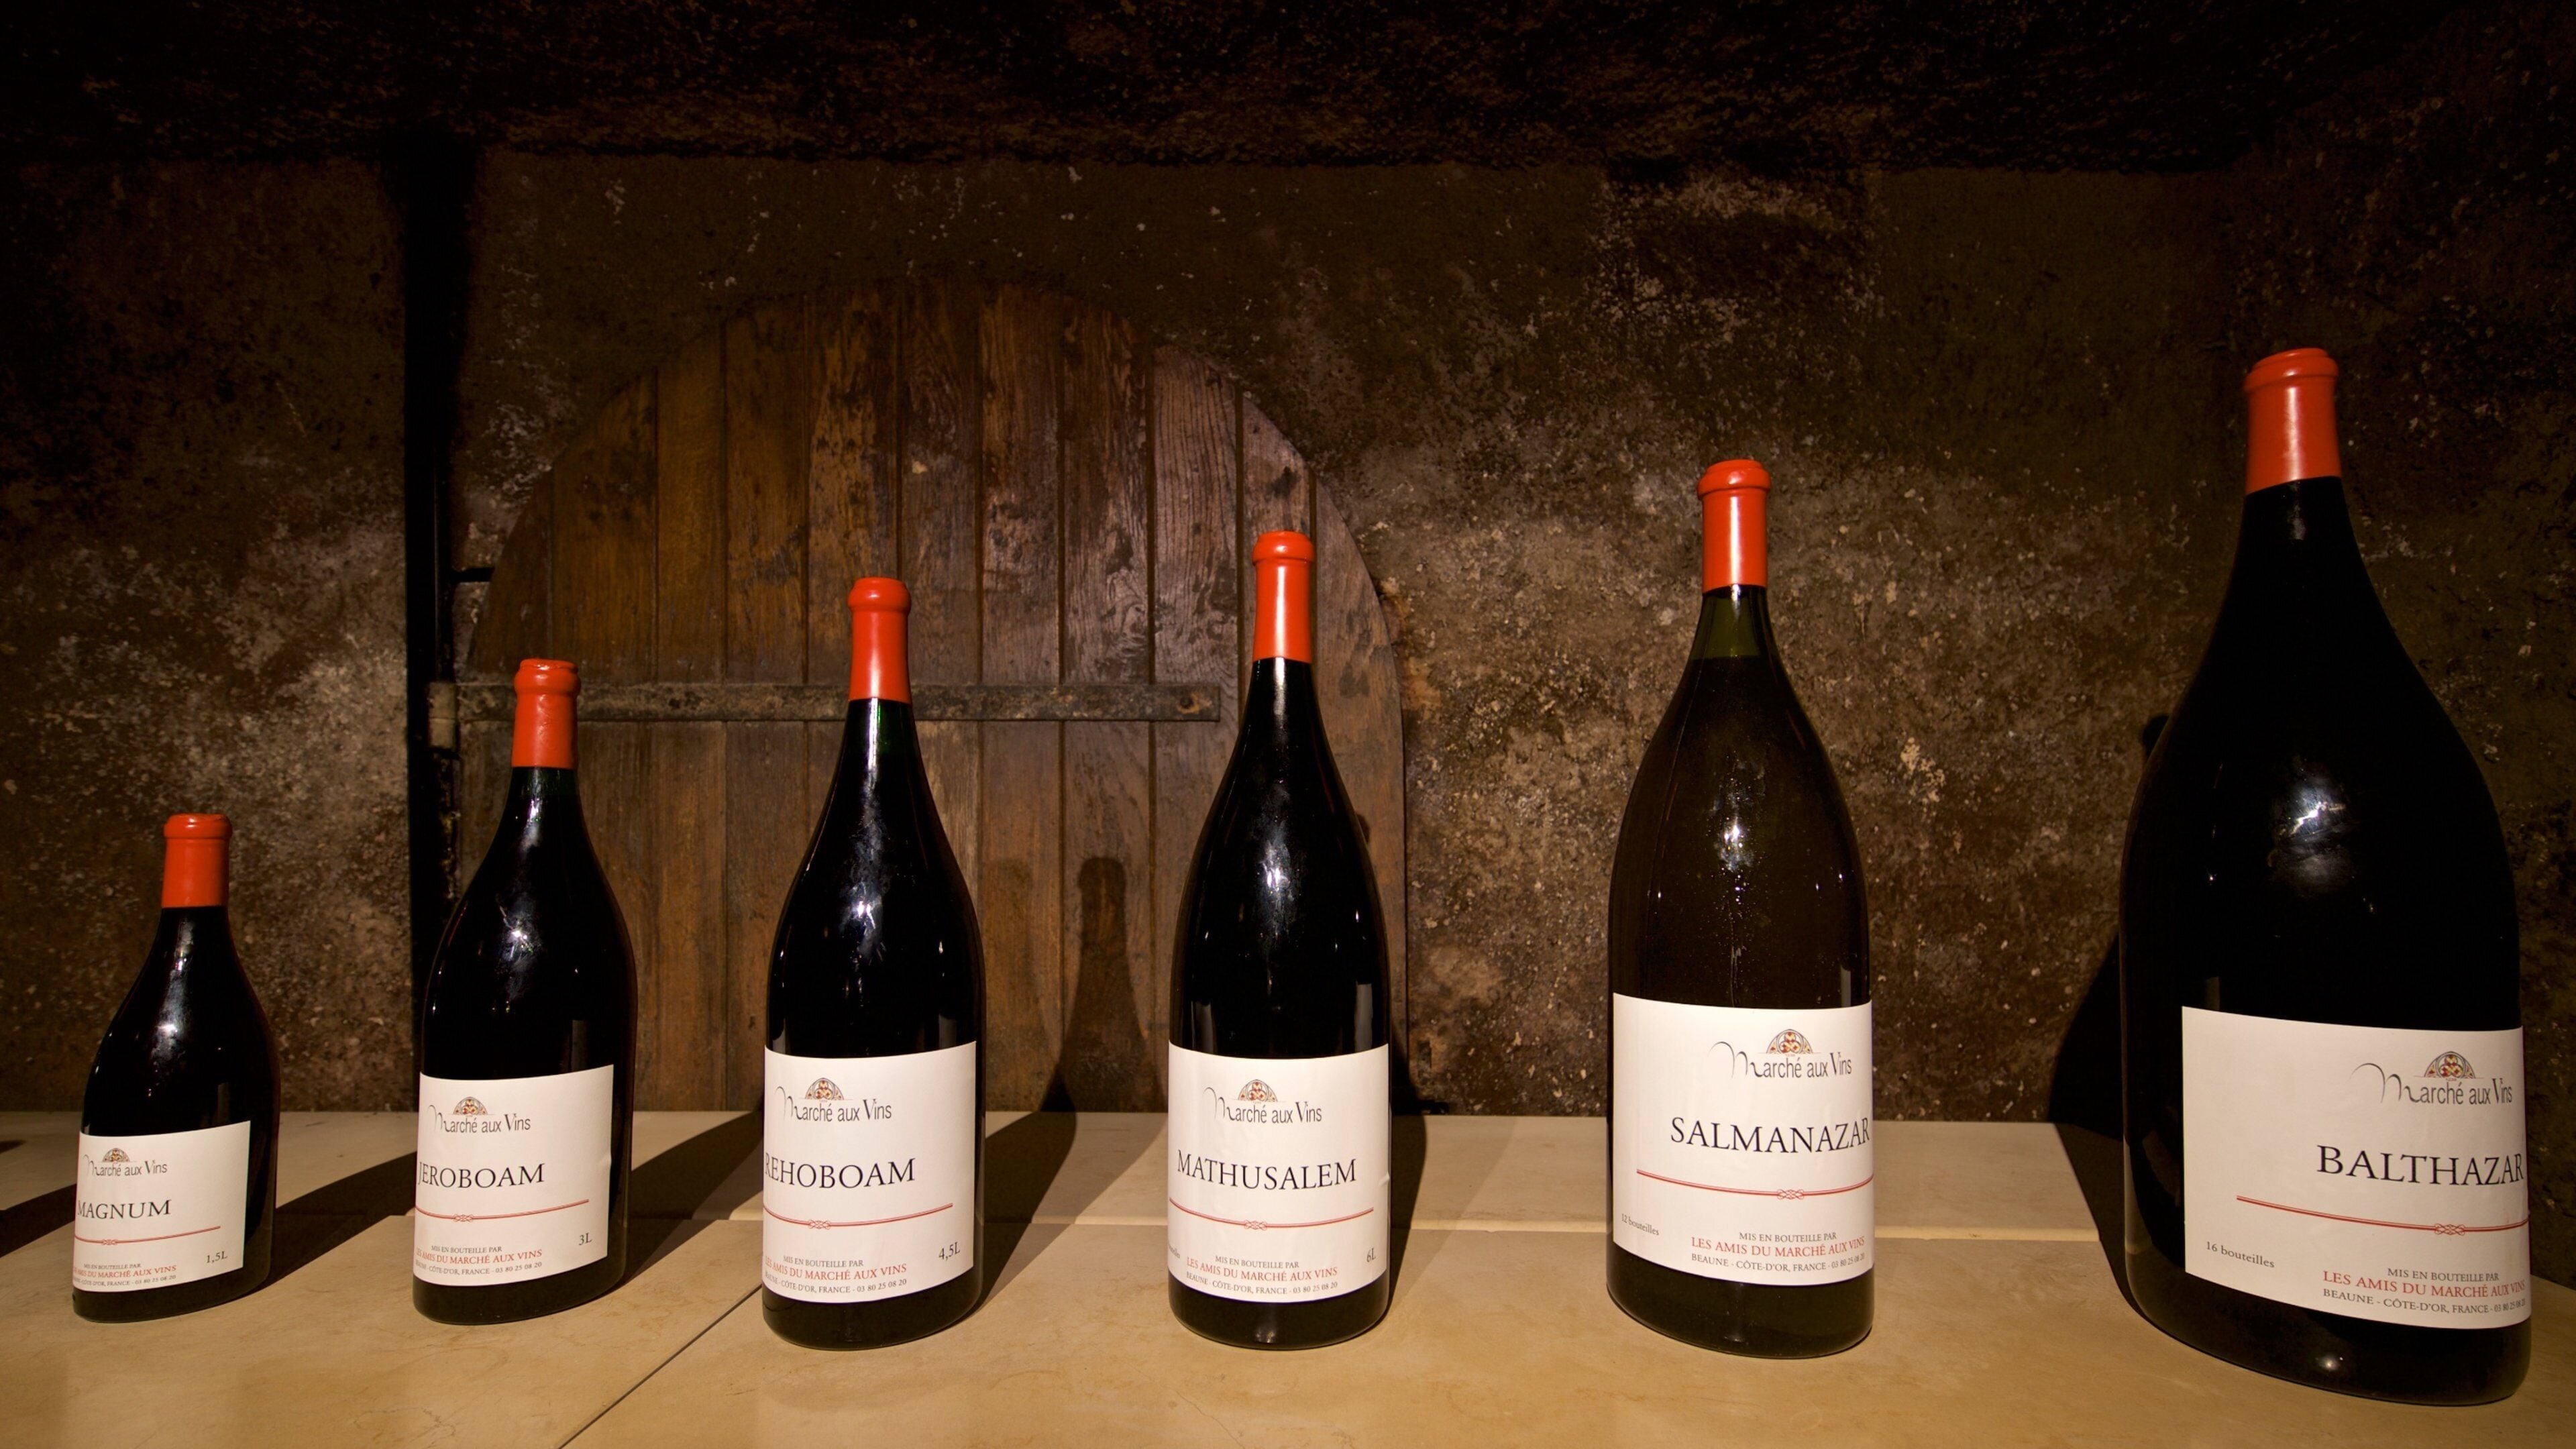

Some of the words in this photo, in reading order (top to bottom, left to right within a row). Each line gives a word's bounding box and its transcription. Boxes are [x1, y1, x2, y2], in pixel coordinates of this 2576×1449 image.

[1707, 1041, 1801, 1078] Marché
[1807, 1062, 1828, 1077] aux
[1829, 1052, 1851, 1075] Vins
[2350, 1063, 2464, 1105] Marché
[2469, 1088, 2490, 1104] aux
[2491, 1077, 2512, 1104] Vins
[775, 1086, 833, 1122] Marché
[837, 1106, 860, 1122] aux
[863, 1099, 892, 1120] Vins
[1203, 1087, 1267, 1124] Marché
[1271, 1108, 1293, 1124] aux
[1295, 1102, 1322, 1123] Vins
[427, 1105, 477, 1133] Marché
[481, 1120, 502, 1133] aux
[504, 1113, 531, 1132] Vins
[1670, 1116, 1870, 1153] SALMANAZAR
[84, 1154, 121, 1177] Marché
[124, 1163, 142, 1176] aux
[144, 1161, 168, 1175] Vins
[418, 1162, 545, 1189] JEROBOAM
[765, 1152, 916, 1189] REHOBOAM
[1177, 1149, 1356, 1191] MATHUSALEM
[2316, 1144, 2524, 1186] BALTHAZAR
[77, 1199, 172, 1220] MAGNUM
[1628, 1216, 1659, 1236] bouteilles
[578, 1232, 592, 1246] 3L
[1691, 1237, 1711, 1249] LES
[1715, 1242, 1747, 1254] AMIS
[1752, 1245, 1771, 1256] DU
[1775, 1244, 1825, 1257] MARCHÉ
[1828, 1242, 1847, 1254] AUX
[1849, 1236, 1865, 1249] VINS
[1739, 1232, 1757, 1240] MIS
[1774, 1234, 1822, 1242] BOUTEILLE
[1824, 1232, 1837, 1240] PAR
[206, 1250, 228, 1264] 1,5L
[449, 1256, 490, 1265] MARCHÉ
[493, 1254, 515, 1263] AUX
[517, 1249, 542, 1260] VINS
[938, 1241, 960, 1261] 4,5L
[1366, 1247, 1376, 1263] 6L
[2206, 1241, 2218, 1252] 16
[2221, 1245, 2275, 1269] bouteilles
[772, 1264, 788, 1275] AMIS
[790, 1267, 802, 1278] DU
[805, 1270, 851, 1281] MARCHÉ
[853, 1269, 878, 1280] AUX
[880, 1263, 906, 1275] VINS
[806, 1259, 847, 1267] BOUTEILLE
[1186, 1256, 1198, 1269] LES
[1199, 1263, 1221, 1275] AMIS
[1224, 1268, 1238, 1279] DU
[1241, 1271, 1287, 1282] MARCHÉ
[1290, 1271, 1312, 1281] AUX
[1315, 1267, 1338, 1279] VINS
[1215, 1255, 1228, 1265] MIS
[1241, 1260, 1283, 1269] BOUTEILLE
[1691, 1253, 1729, 1267] BEAUNE
[1793, 1263, 1826, 1272] FRANCE
[1831, 1261, 1839, 1269] 03
[2323, 1271, 2351, 1285] LES
[2356, 1277, 2397, 1292] AMIS
[2403, 1283, 2426, 1295] DU
[2431, 1284, 2488, 1297] MARCHÉ
[2491, 1285, 2509, 1297] AUX
[2387, 1268, 2409, 1278] MIS
[2413, 1271, 2427, 1279] EN
[2431, 1273, 2483, 1282] BOUTEILLE
[2485, 1273, 2499, 1281] PAR
[818, 1285, 851, 1293] FRANCE
[1256, 1287, 1287, 1295] FRANCE
[1313, 1284, 1320, 1292] 25
[2323, 1289, 2373, 1305] BEAUNE
[2452, 1305, 2489, 1313] FRANCE
